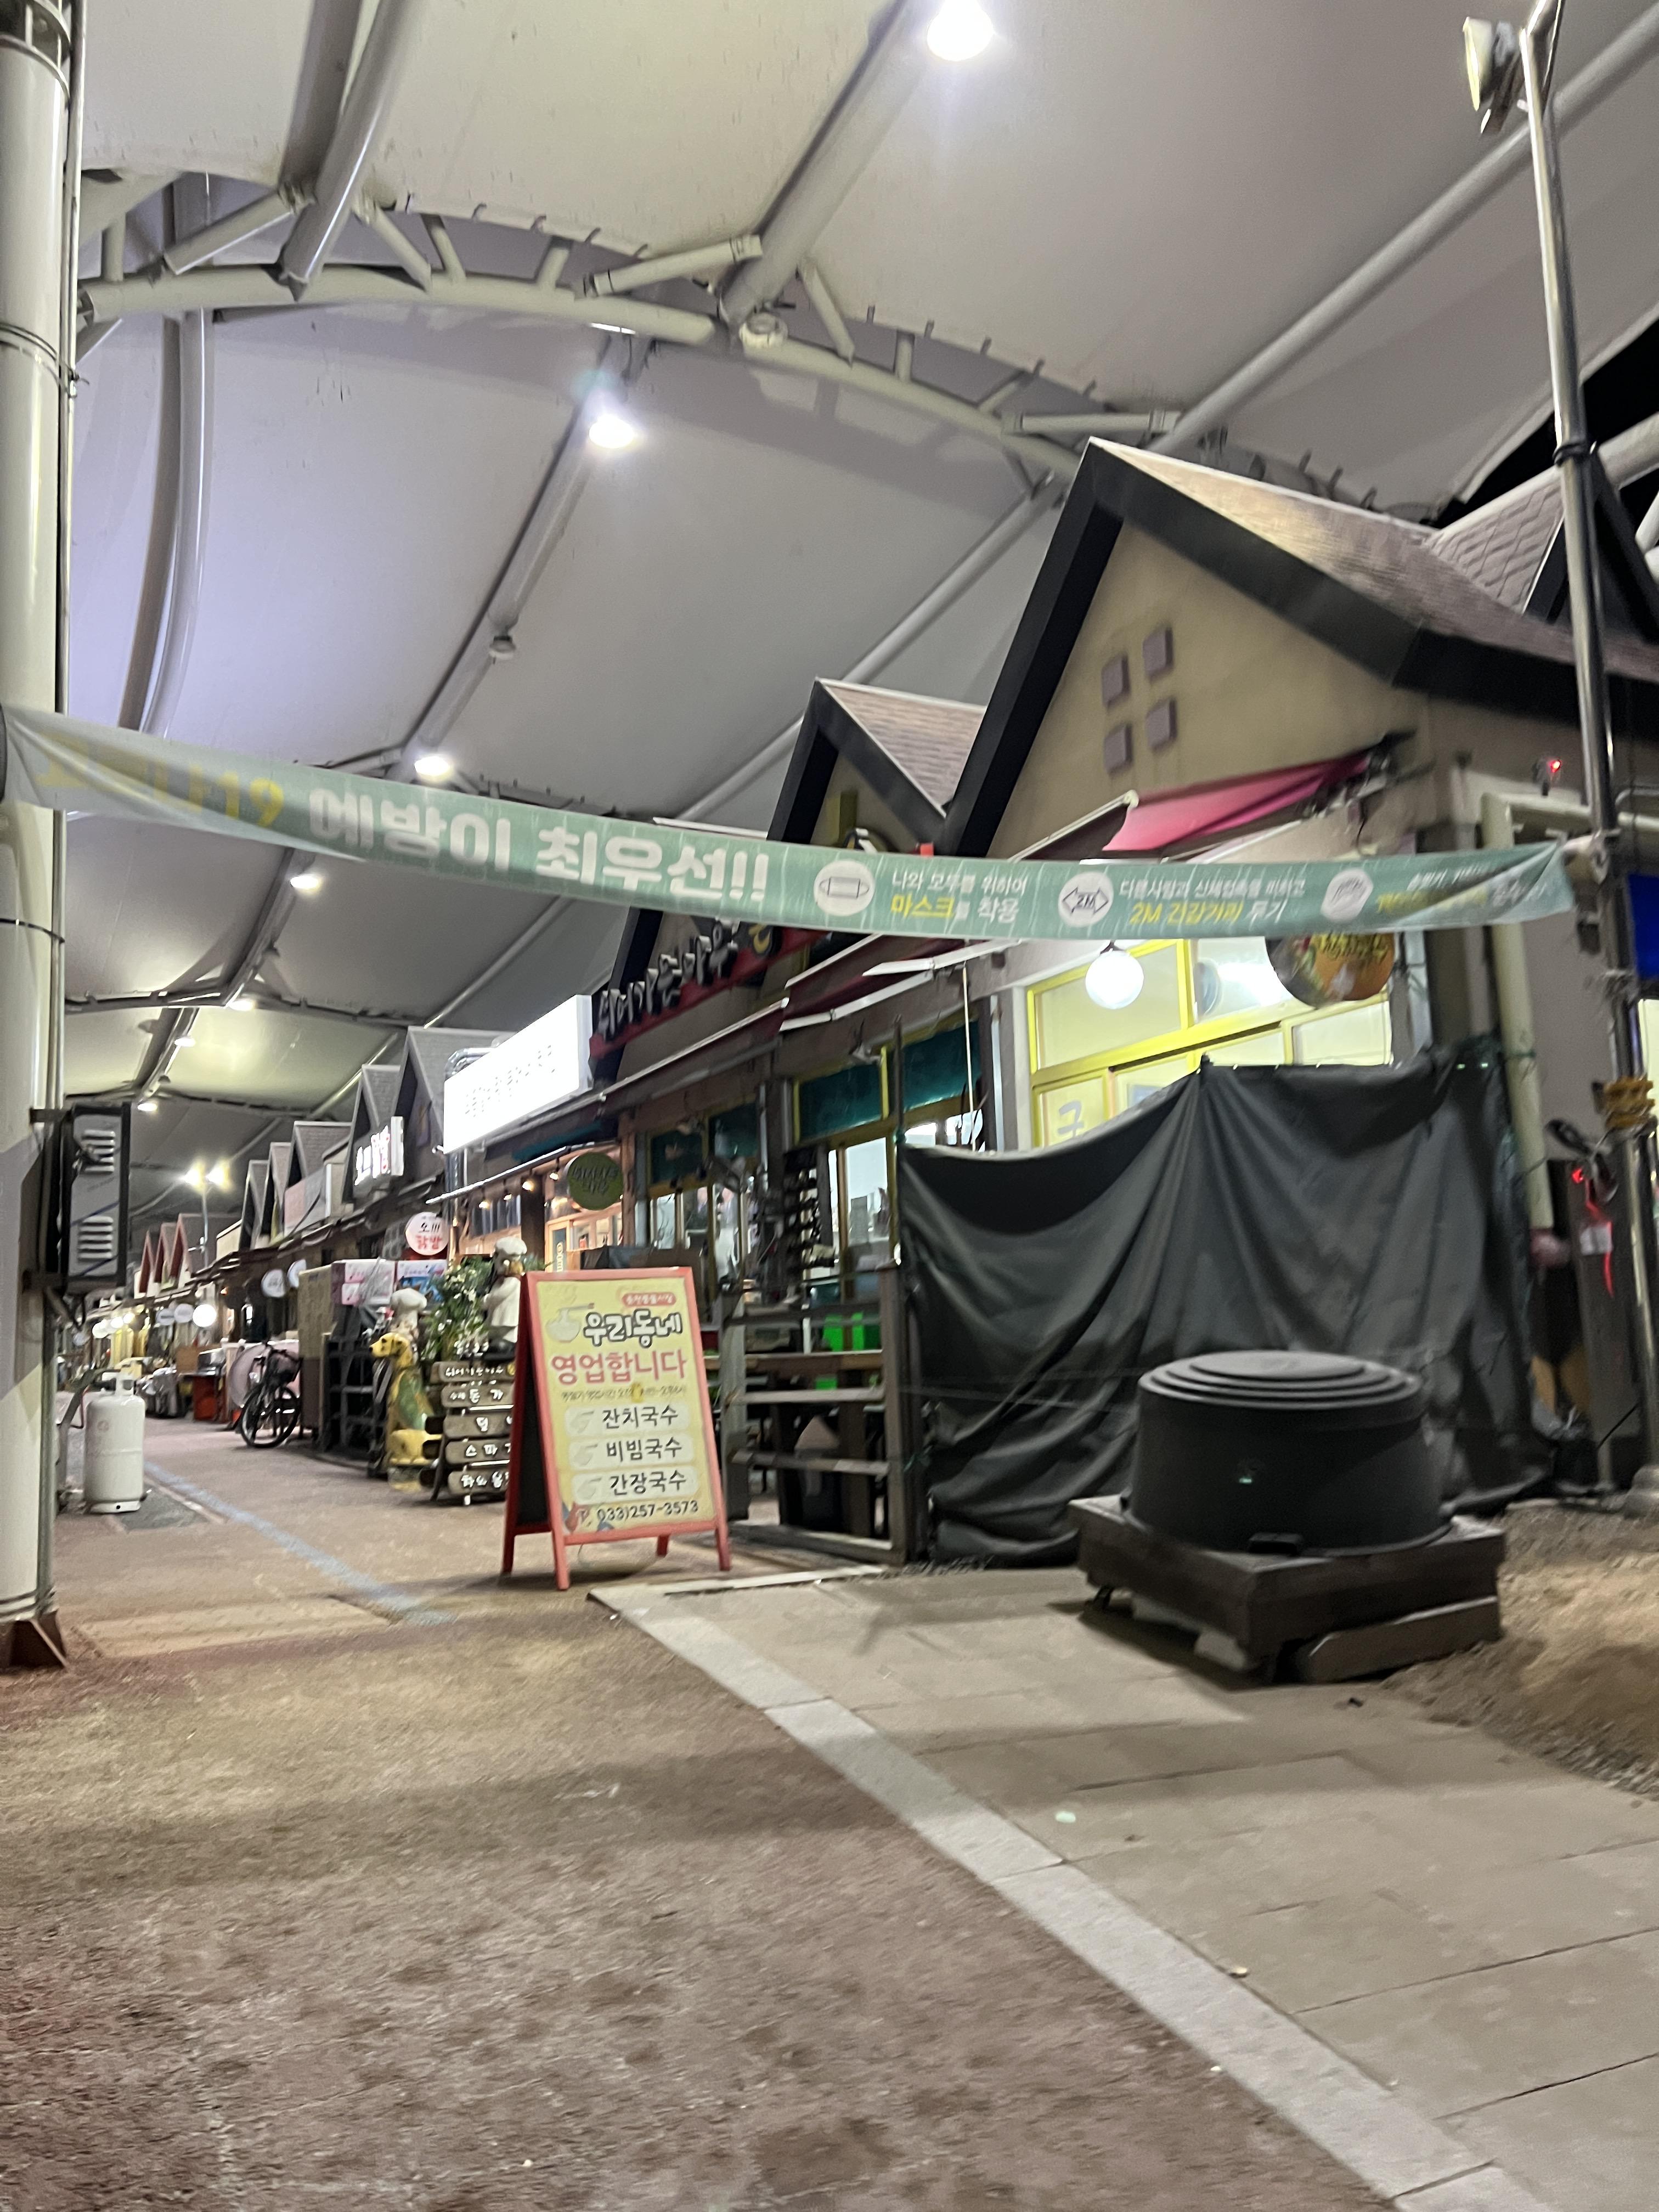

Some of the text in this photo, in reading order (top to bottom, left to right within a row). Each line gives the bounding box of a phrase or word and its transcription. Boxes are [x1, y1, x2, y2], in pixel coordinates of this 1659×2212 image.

[309, 788, 511, 873] 예방이
[535, 826, 769, 901] 최우선!!
[892, 869, 924, 892] 나와
[978, 896, 1019, 924] 착용
[1130, 902, 1161, 925] 2M
[584, 1308, 684, 1347] 우리동네
[551, 1351, 687, 1385] 영업합니다
[602, 1404, 679, 1429] 잔치국수
[606, 1436, 683, 1460] 비빔국수
[610, 1470, 687, 1496] 간장국수
